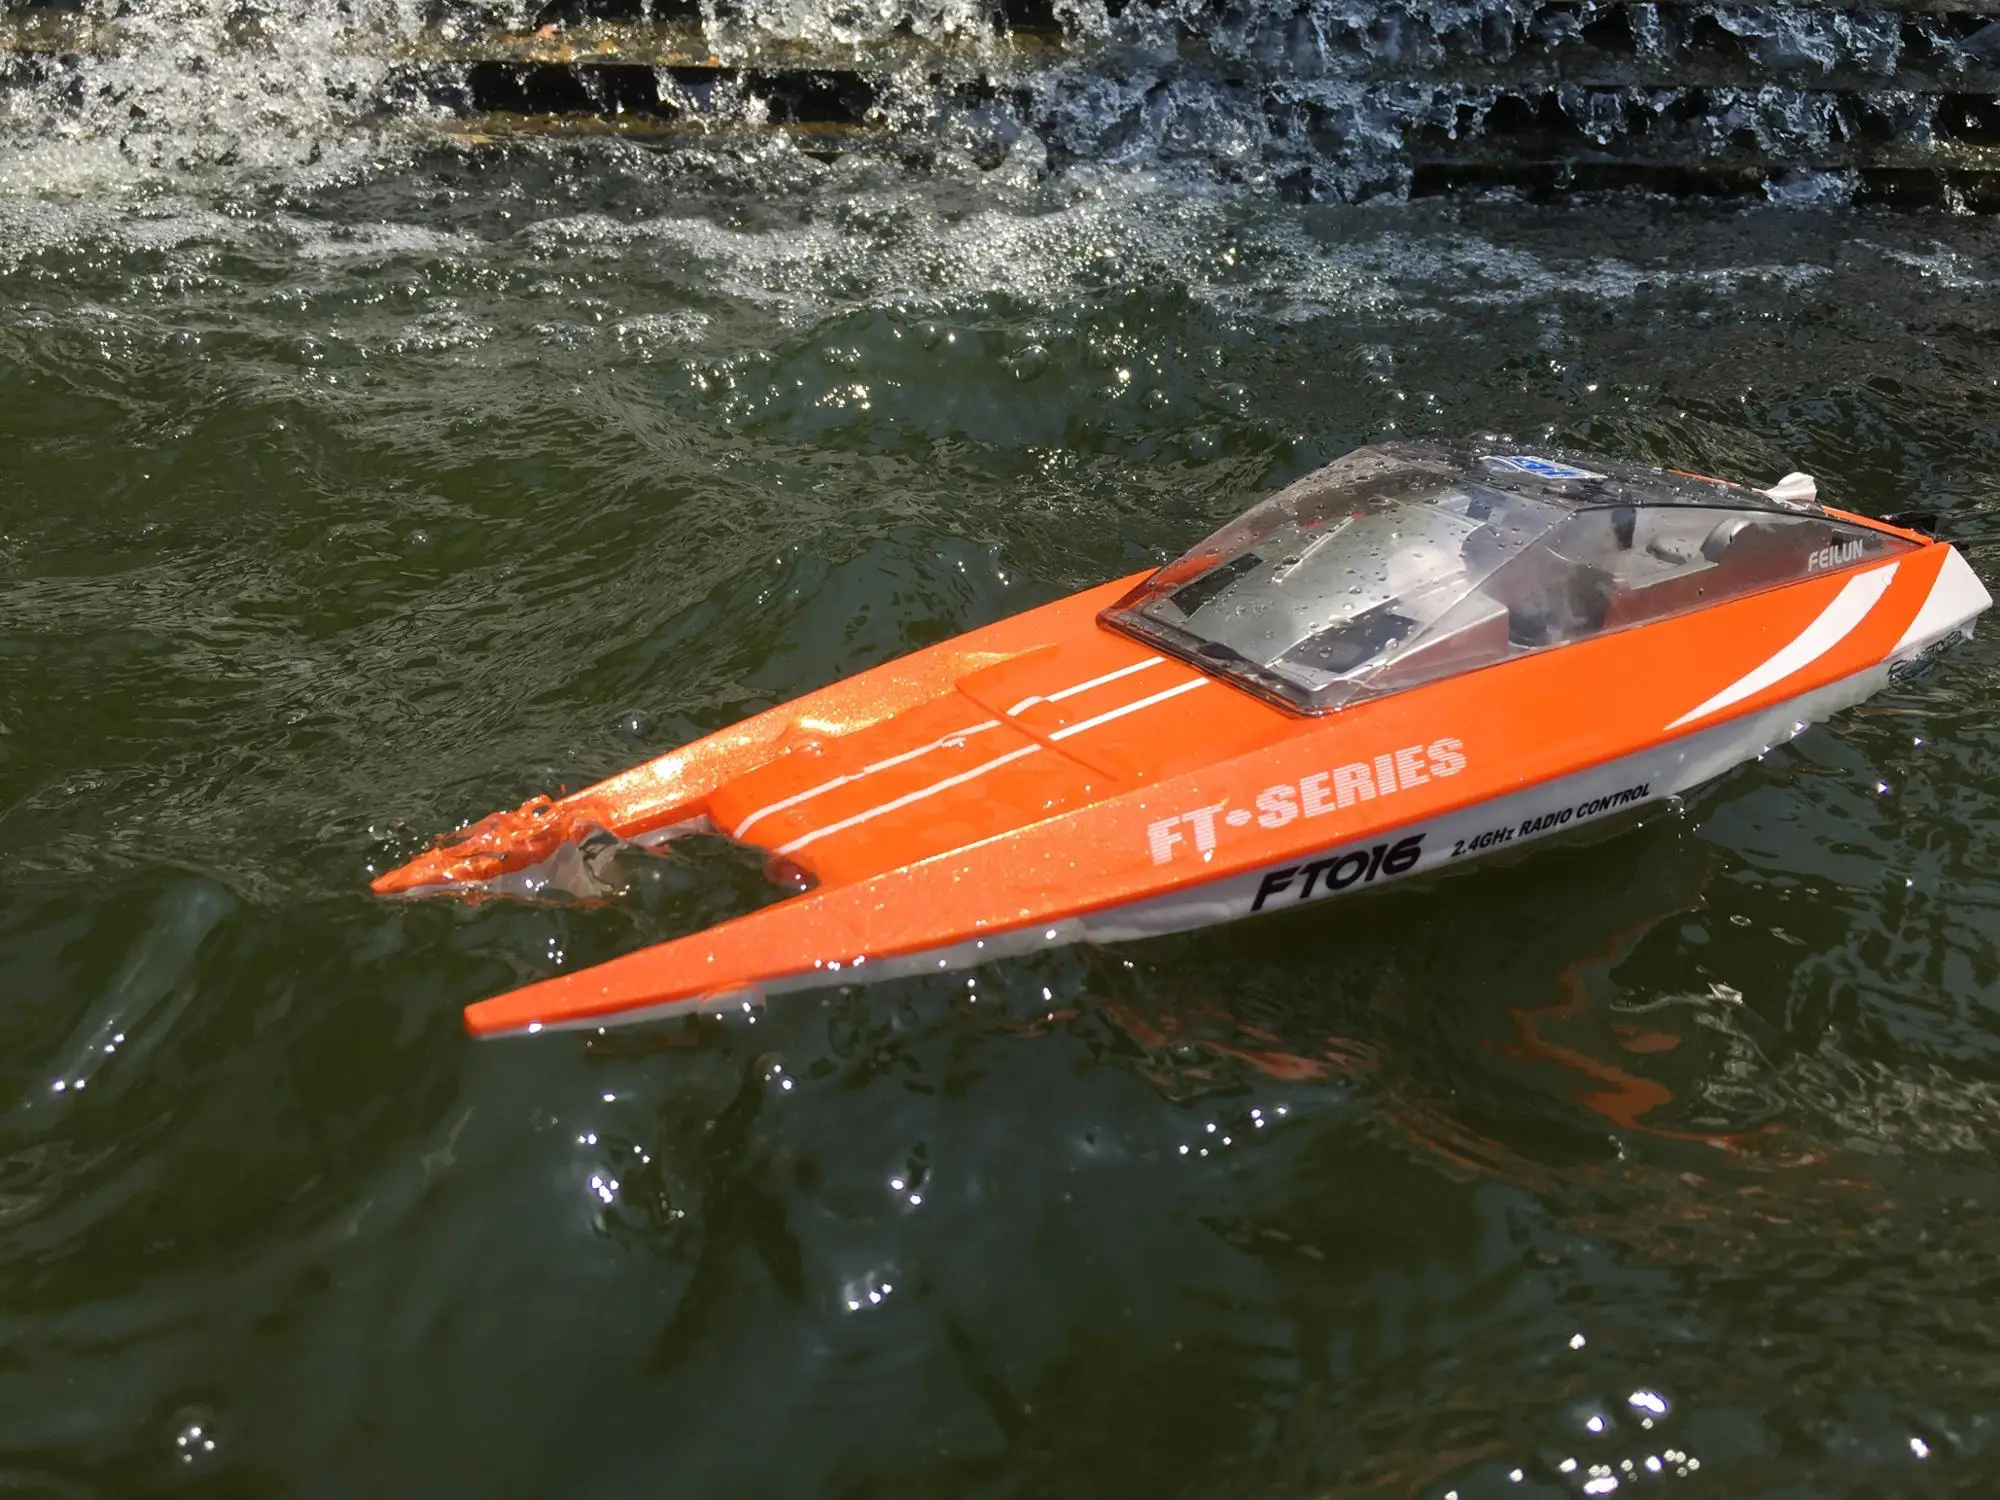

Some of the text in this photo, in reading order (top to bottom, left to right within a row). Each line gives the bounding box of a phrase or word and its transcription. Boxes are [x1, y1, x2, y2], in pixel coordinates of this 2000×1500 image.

[1808, 539, 1863, 573] FEILUN
[1451, 783, 1650, 857] 2.4GHz RADIO CONTROL
